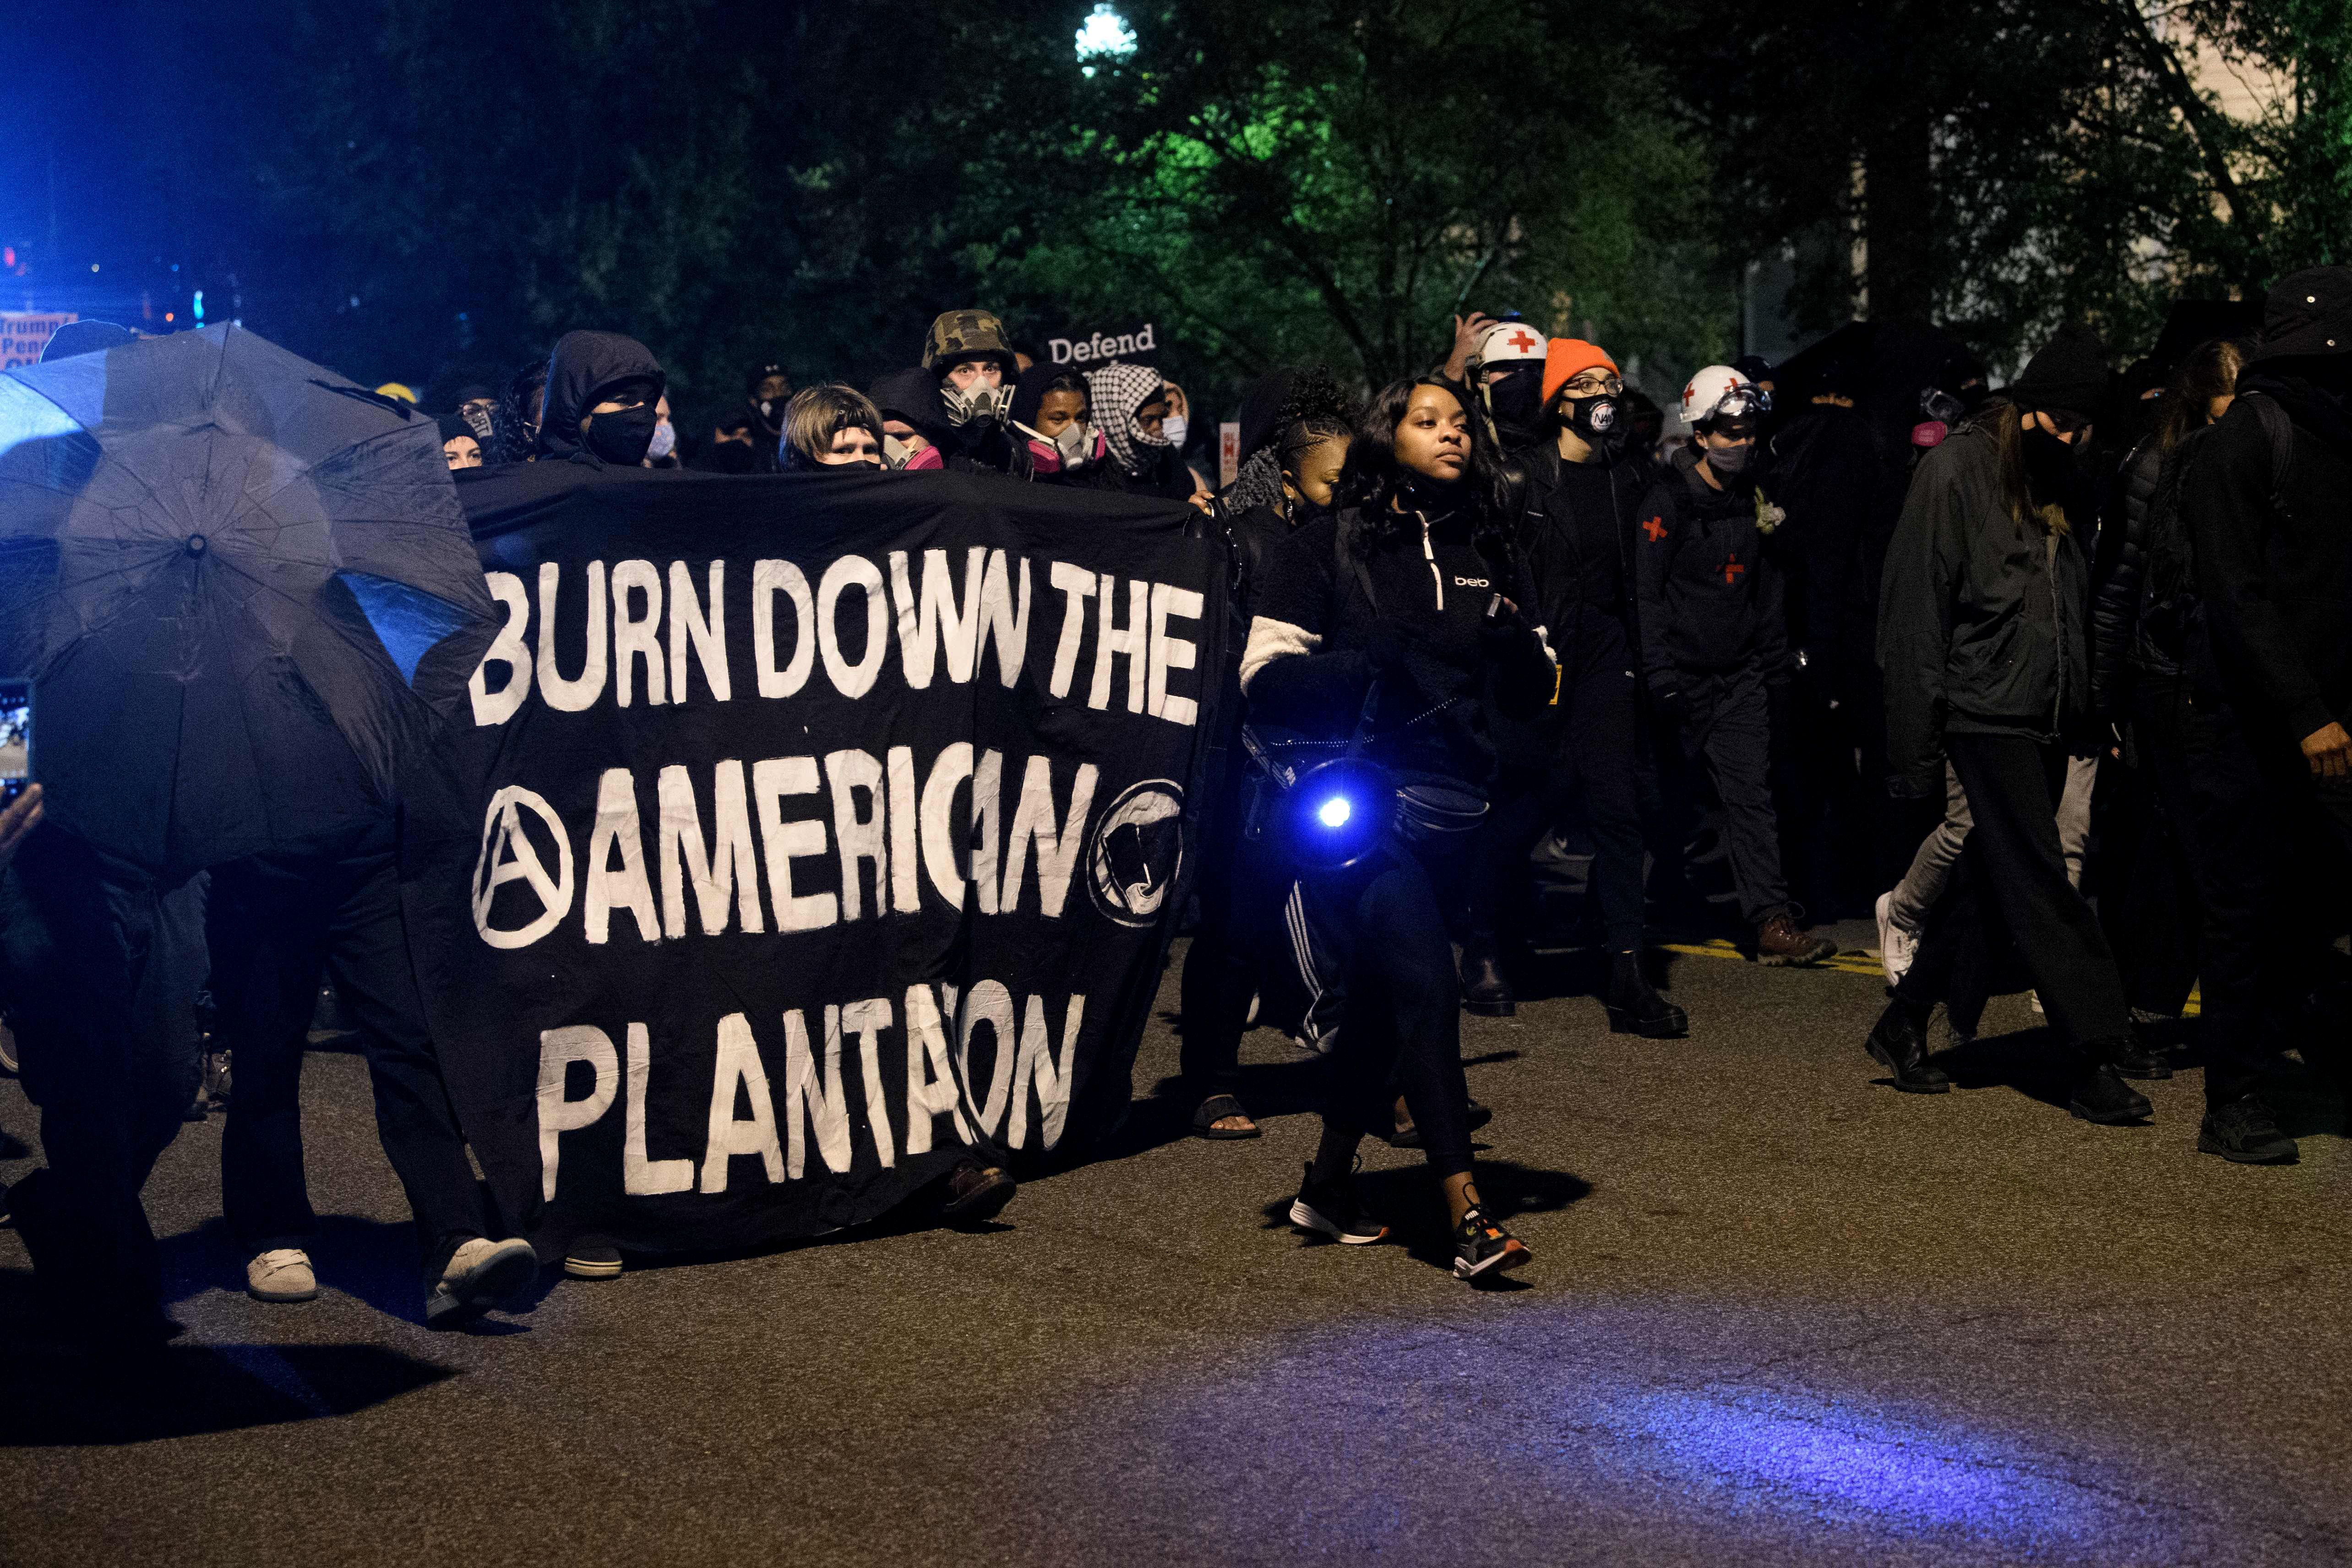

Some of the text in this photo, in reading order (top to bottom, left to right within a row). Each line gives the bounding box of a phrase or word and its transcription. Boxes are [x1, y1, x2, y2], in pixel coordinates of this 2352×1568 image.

[1048, 323, 1157, 365] Defend
[468, 547, 1204, 727] BURN DOWN THE
[584, 742, 1099, 944] AMERICAN
[536, 980, 1085, 1203] PLANTAON
